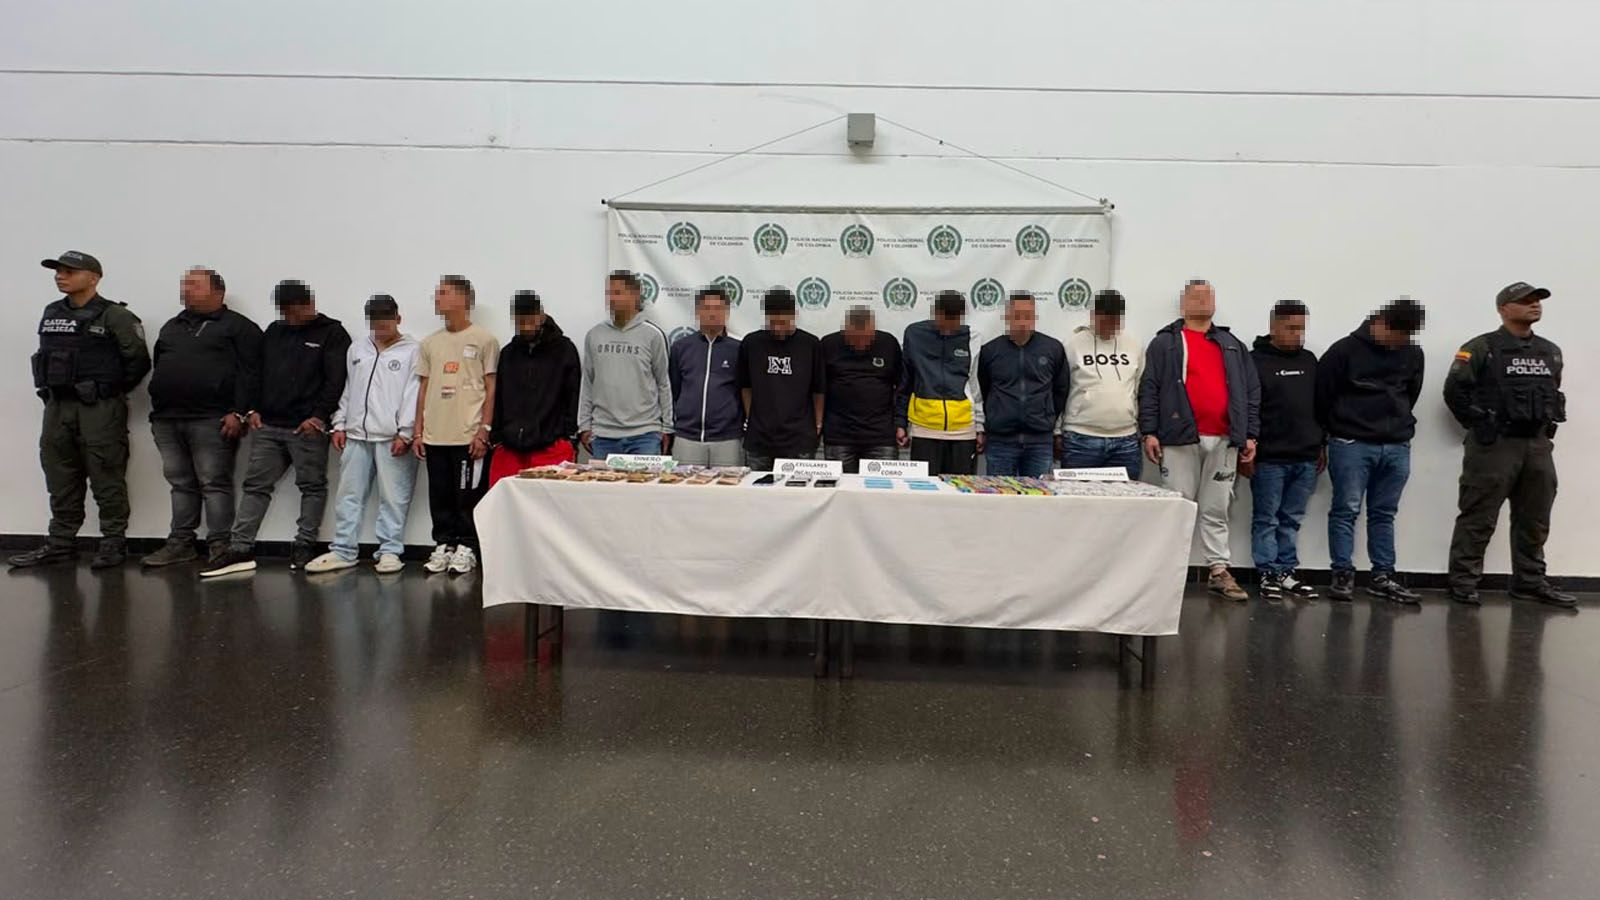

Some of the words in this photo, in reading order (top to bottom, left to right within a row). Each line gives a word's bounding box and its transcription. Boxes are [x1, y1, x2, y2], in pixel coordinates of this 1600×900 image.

[597, 344, 640, 355] ORIGINS
[1083, 354, 1130, 366] BOSS
[1512, 358, 1546, 367] GAULA
[1506, 366, 1552, 376] POLICIA
